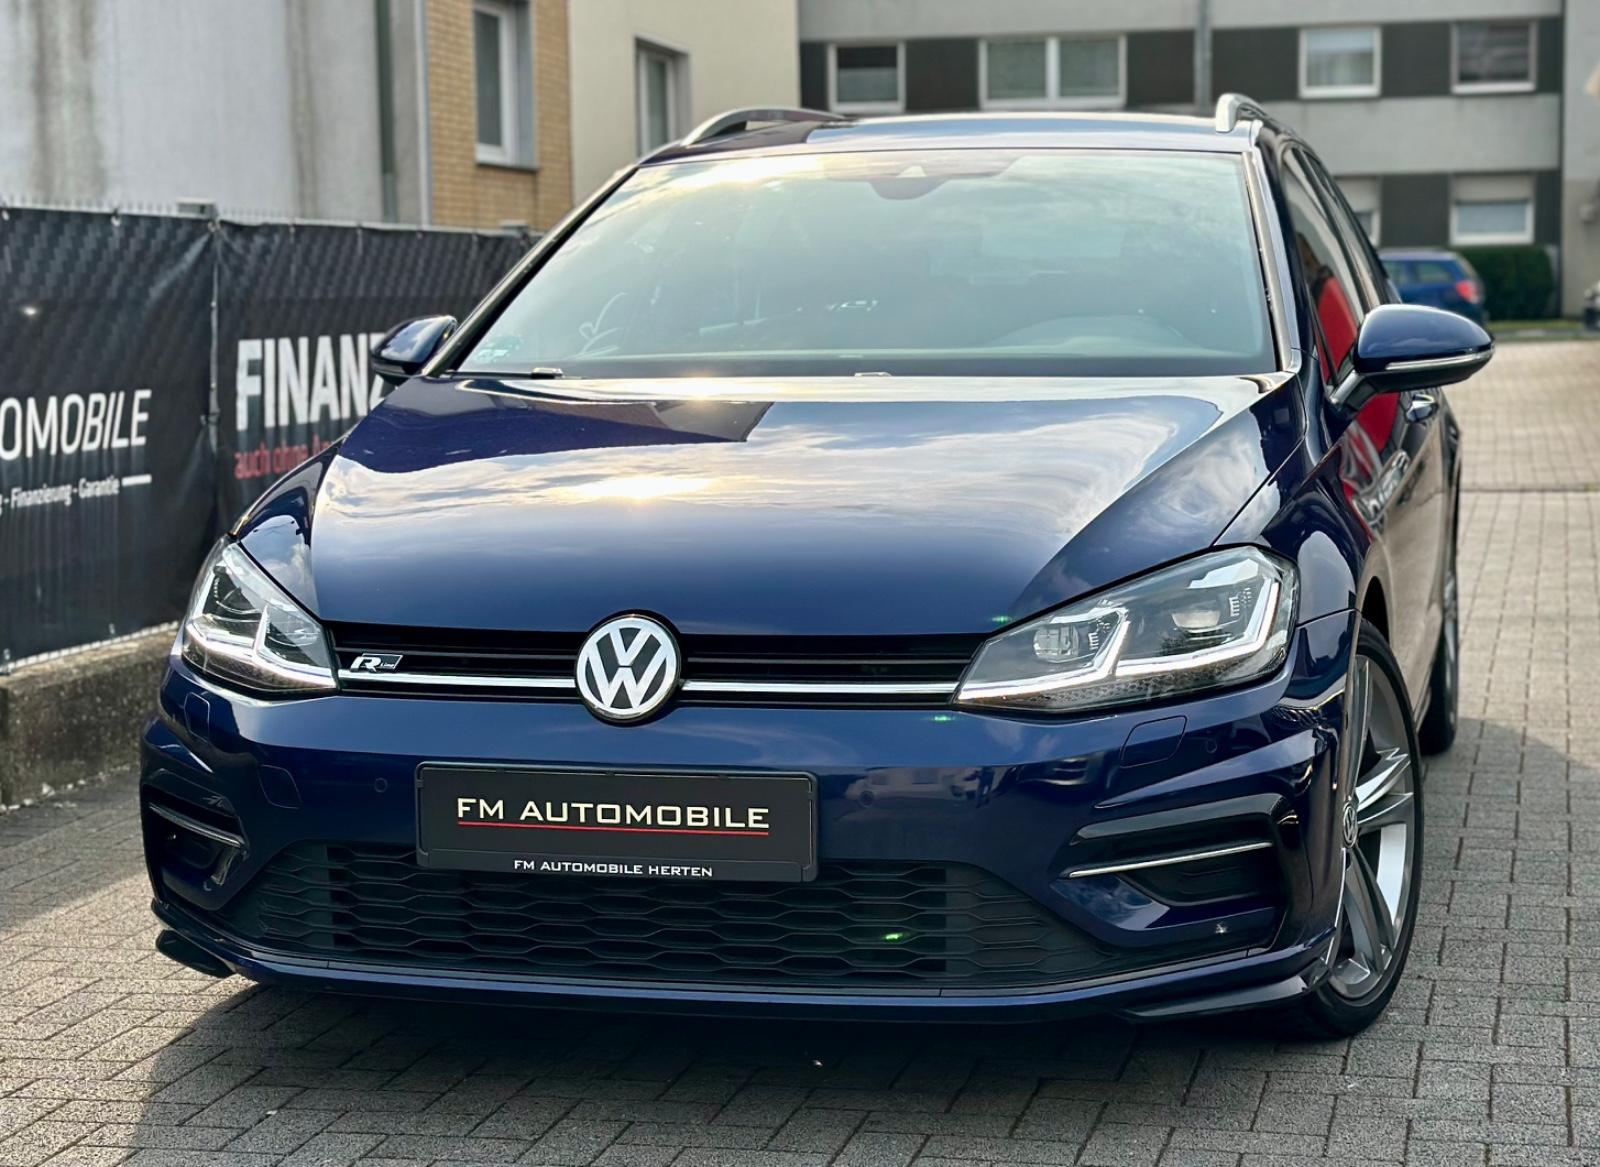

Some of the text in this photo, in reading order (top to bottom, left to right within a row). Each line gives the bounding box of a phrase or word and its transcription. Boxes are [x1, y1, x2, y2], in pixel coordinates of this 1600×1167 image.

[0, 388, 152, 461] OMOBILE
[579, 617, 679, 720] VW
[457, 797, 770, 830] FM AUTOMOBILE
[513, 860, 713, 877] FM AUTOMOBILE HERTEN
